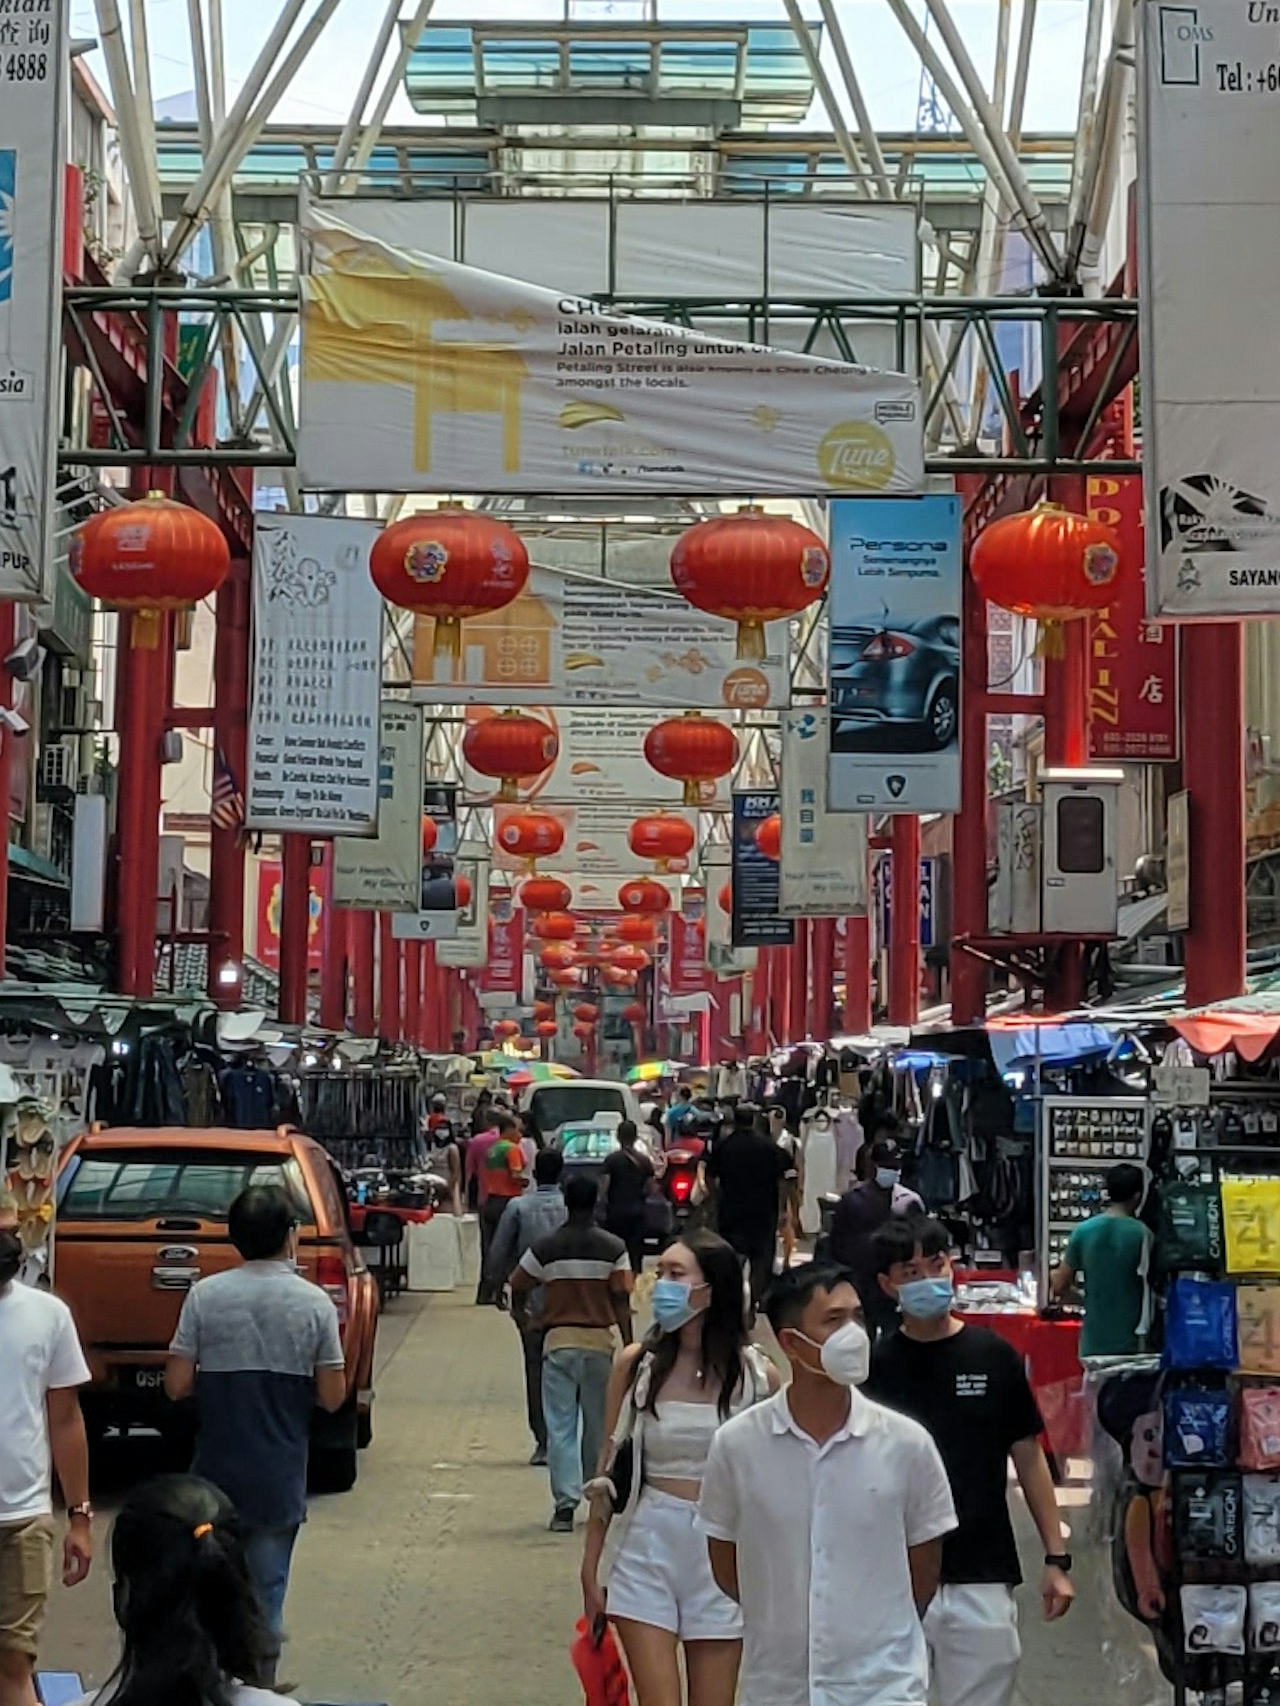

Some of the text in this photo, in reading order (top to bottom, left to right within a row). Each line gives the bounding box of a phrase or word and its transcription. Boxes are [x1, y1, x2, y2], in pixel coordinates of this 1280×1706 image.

[6, 52, 49, 82] 4888
[558, 341, 606, 357] Jalan
[613, 341, 688, 359] Petaling
[619, 374, 643, 388] the
[825, 439, 888, 476] Tune
[849, 536, 949, 553] Persona
